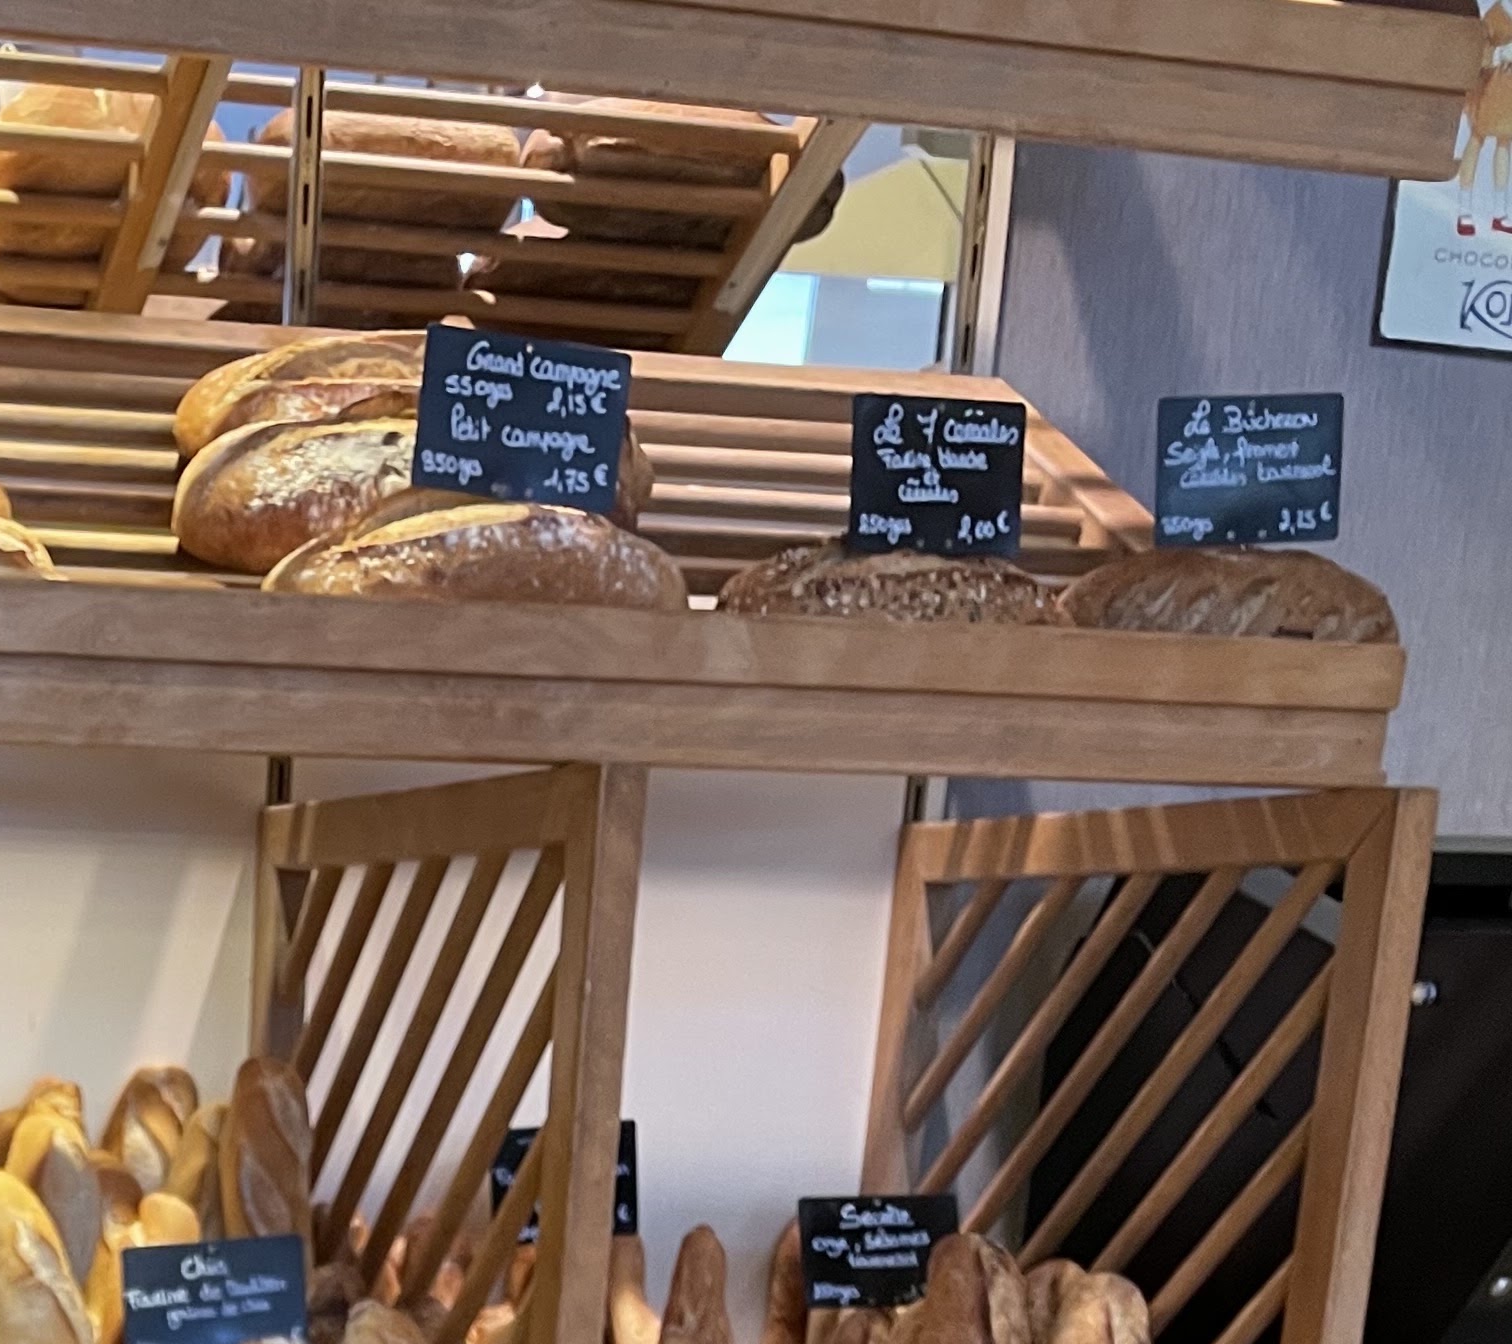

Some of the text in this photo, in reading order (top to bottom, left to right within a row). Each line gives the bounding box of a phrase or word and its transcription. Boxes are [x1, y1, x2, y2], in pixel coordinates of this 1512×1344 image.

[1434, 248, 1512, 269] CHOCO
[1458, 279, 1512, 340] KO
[466, 340, 525, 377] Grand
[450, 402, 491, 443] Petit
